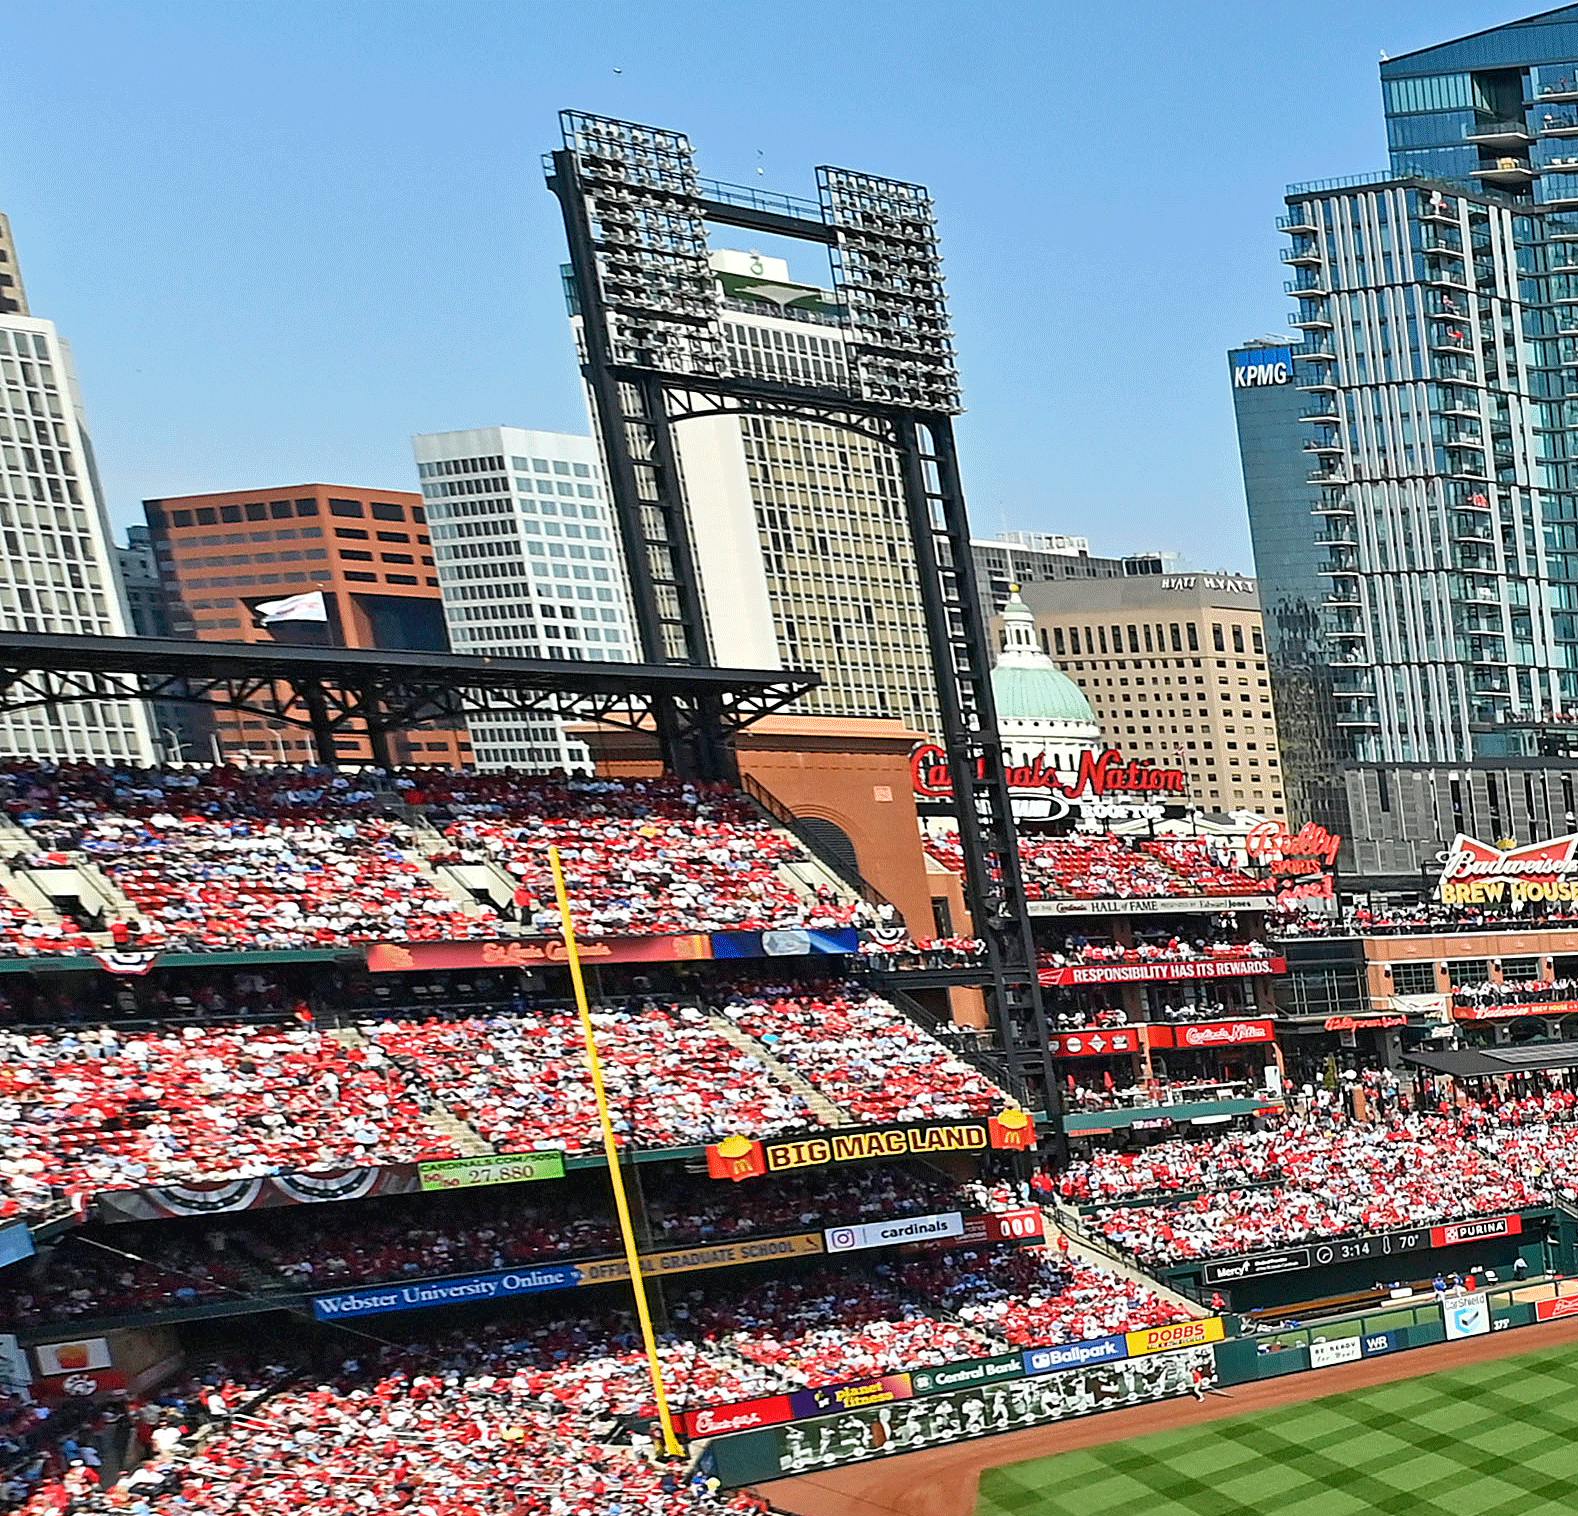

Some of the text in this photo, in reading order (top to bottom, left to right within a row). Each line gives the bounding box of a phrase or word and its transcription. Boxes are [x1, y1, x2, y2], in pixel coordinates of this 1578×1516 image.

[1234, 362, 1287, 387] KPMG
[1161, 577, 1196, 591] HYATT
[1204, 577, 1254, 594] HYATT
[1065, 749, 1185, 799] Nation
[1081, 804, 1166, 820] ROOFTOP
[1270, 860, 1322, 875] SPORTS
[1436, 850, 1578, 878] Budweiser
[1441, 882, 1504, 905] BREW
[1091, 902, 1121, 913] HALL
[1129, 901, 1158, 912] FAME
[1228, 899, 1251, 909] Jones
[1073, 965, 1169, 983] RESPONSIBILITY
[1171, 964, 1194, 979] HAS
[1196, 963, 1214, 977] ITS
[1216, 961, 1273, 977] REWARDS.
[1475, 1004, 1530, 1019] Budweiser
[769, 1126, 986, 1169] BIG MAC LAND
[420, 1153, 559, 1172] CARDINALS.COM/5050
[881, 1220, 948, 1239] cardinals
[1458, 1222, 1504, 1238] PURINA
[659, 1240, 796, 1269] GRADUATE SCHOOL
[1341, 1244, 1370, 1258] 3:14
[1216, 1262, 1244, 1279] Mercy
[317, 1268, 565, 1315] Webster University Online
[1444, 1294, 1485, 1310] CarShield
[1147, 1323, 1204, 1344] DOBBS
[1049, 1341, 1119, 1364] Ballpark
[935, 1359, 1022, 1385] Central Bank
[836, 1382, 883, 1402] planet
[844, 1391, 895, 1408] fitness
